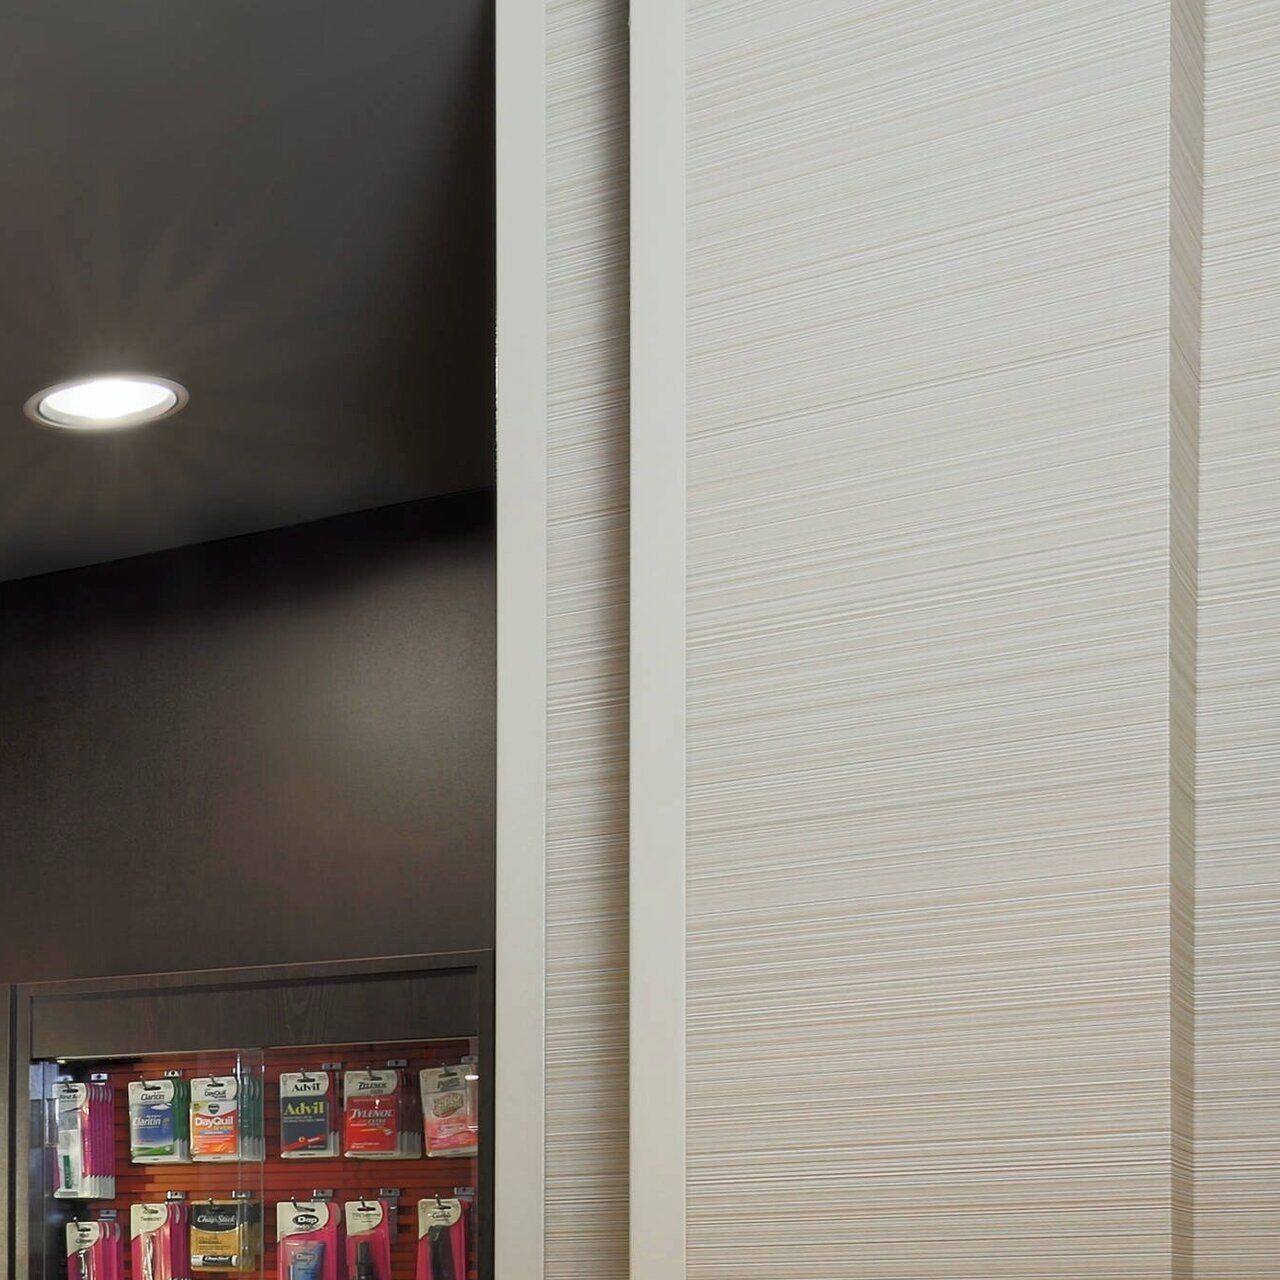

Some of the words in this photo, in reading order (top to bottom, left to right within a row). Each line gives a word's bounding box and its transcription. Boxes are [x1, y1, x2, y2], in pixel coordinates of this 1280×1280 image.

[292, 1083, 320, 1092] Advil
[141, 1093, 165, 1101] Claritin
[284, 1102, 324, 1115] Advil
[351, 1108, 393, 1118] TYLENOL
[194, 1116, 234, 1128] DayQuil
[196, 1214, 236, 1224] ChapStick
